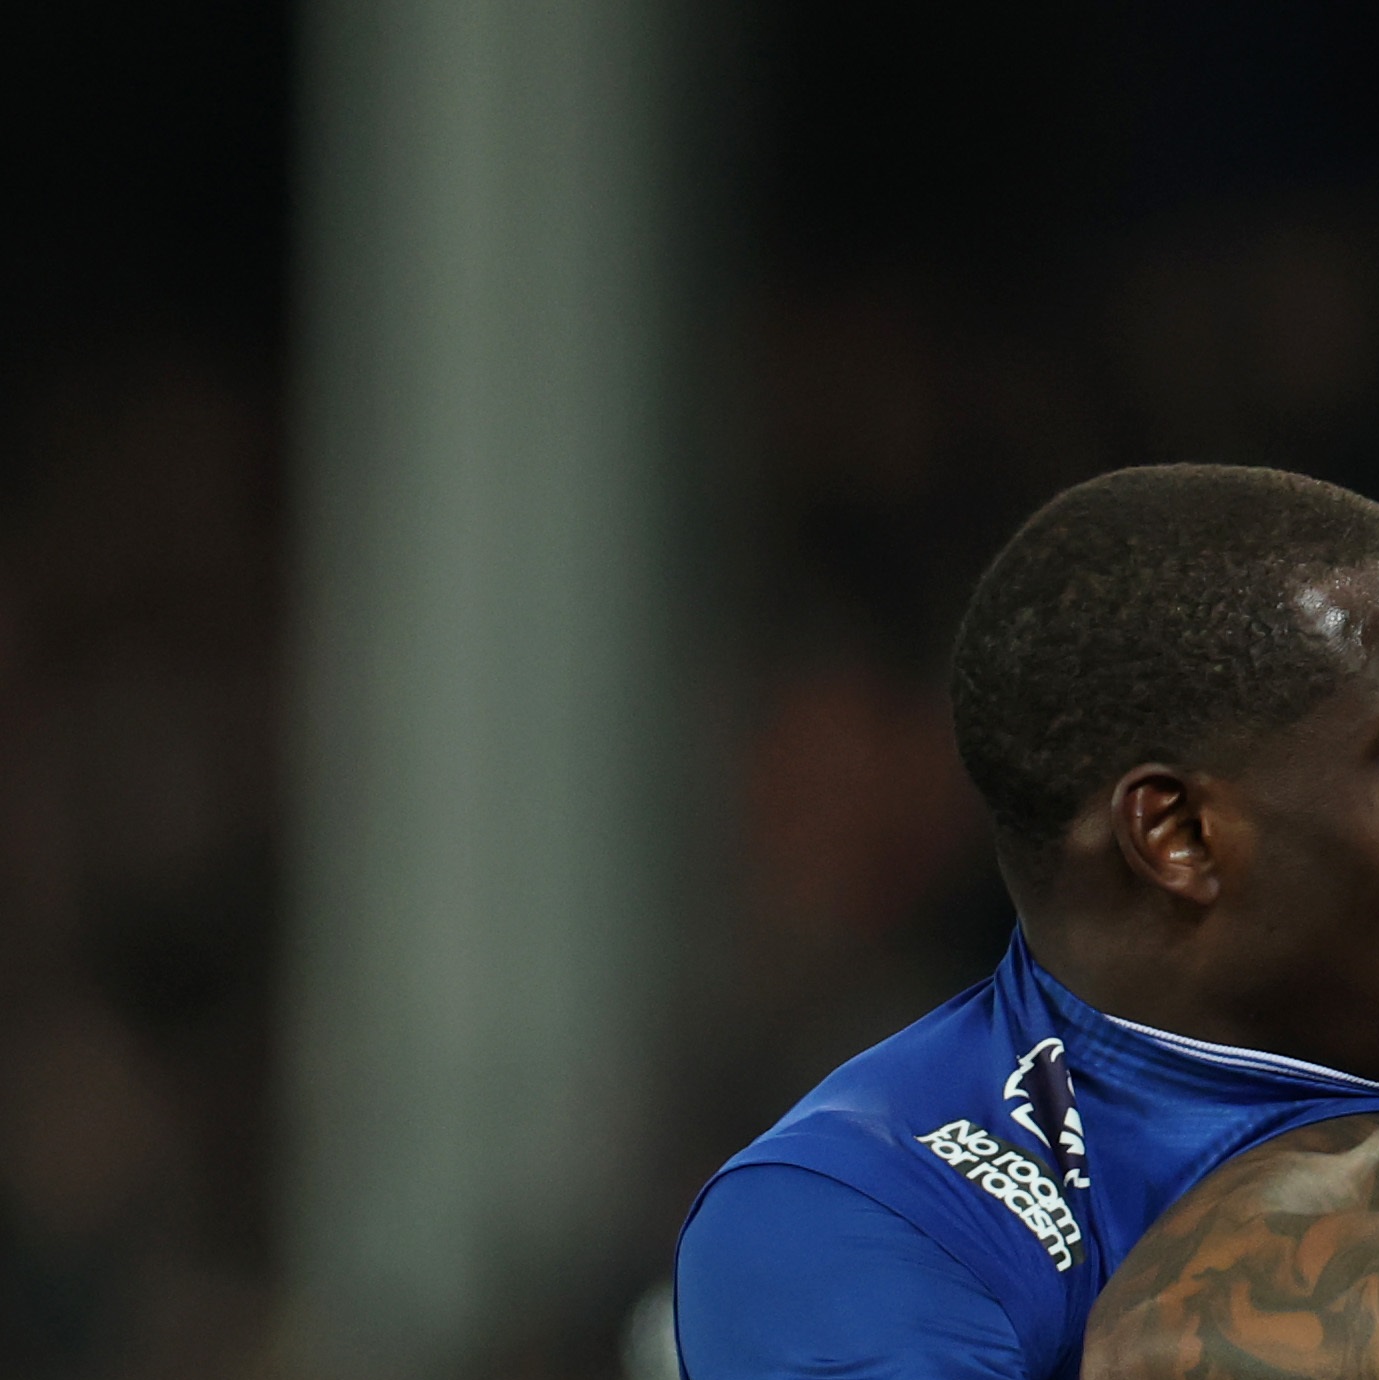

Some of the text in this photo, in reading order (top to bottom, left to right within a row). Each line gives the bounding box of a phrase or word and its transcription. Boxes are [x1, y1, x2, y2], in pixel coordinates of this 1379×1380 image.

[938, 1119, 1082, 1245] No room
[966, 1162, 1072, 1272] racism
